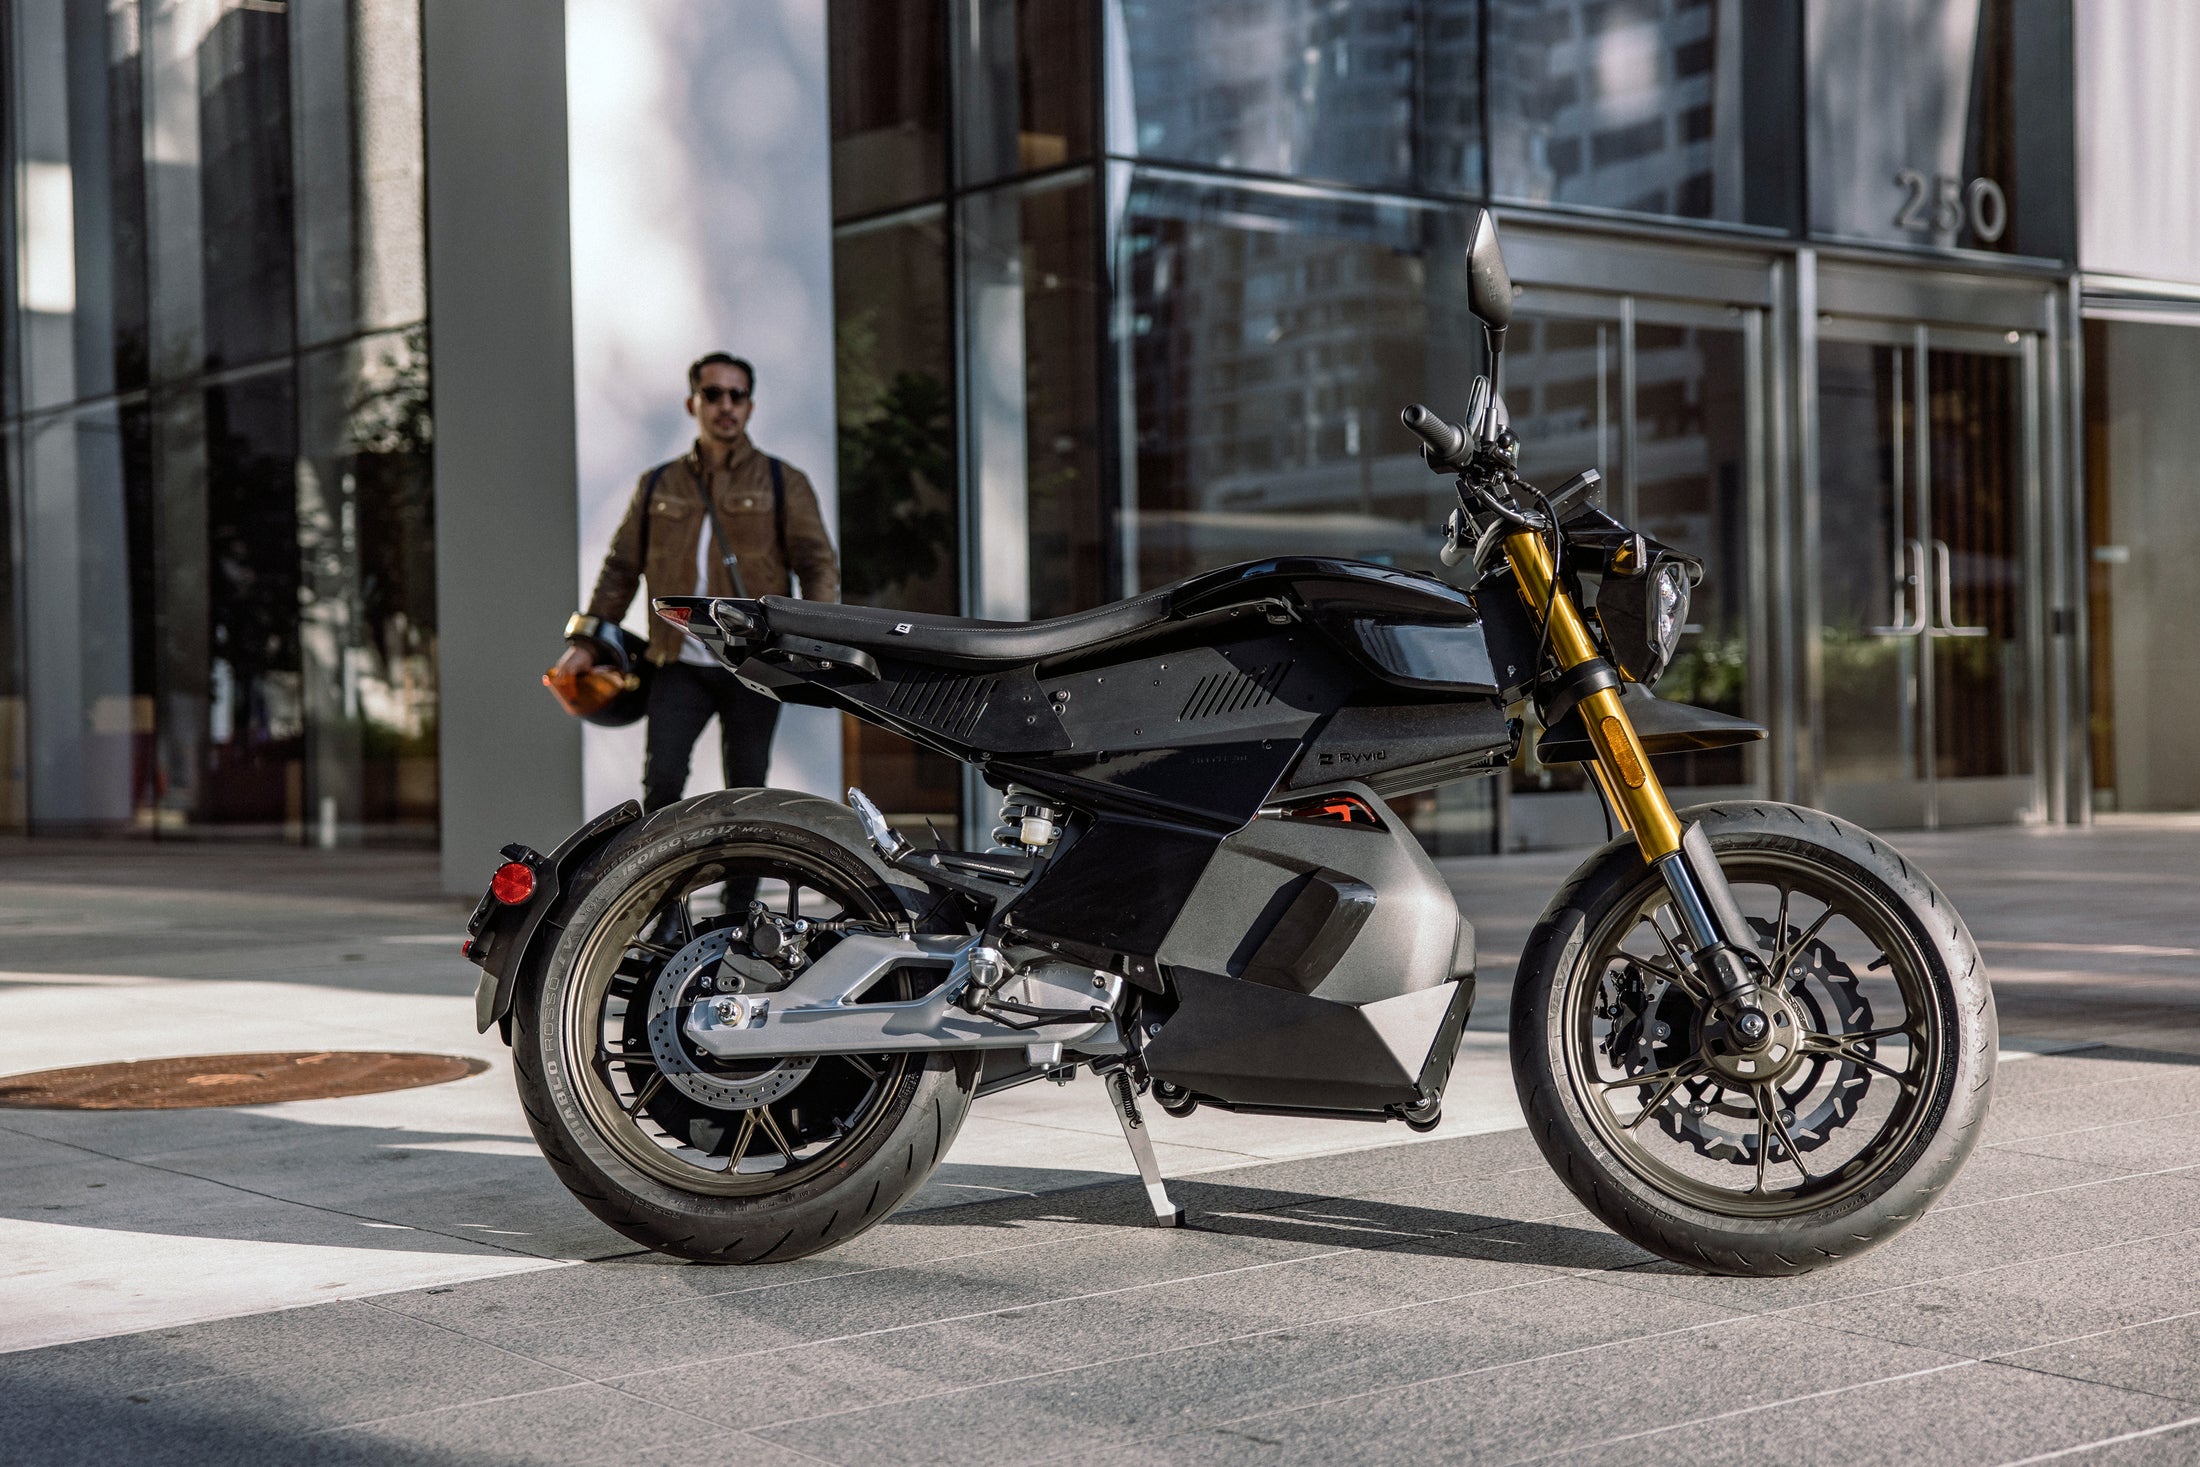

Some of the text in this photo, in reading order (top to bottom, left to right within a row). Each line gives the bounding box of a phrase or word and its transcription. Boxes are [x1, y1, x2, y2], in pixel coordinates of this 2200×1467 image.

[1892, 168, 2007, 243] 250
[1338, 749, 1386, 764] Ryvid
[543, 977, 560, 1052] ROSSO
[547, 1060, 589, 1143] DIABLO
